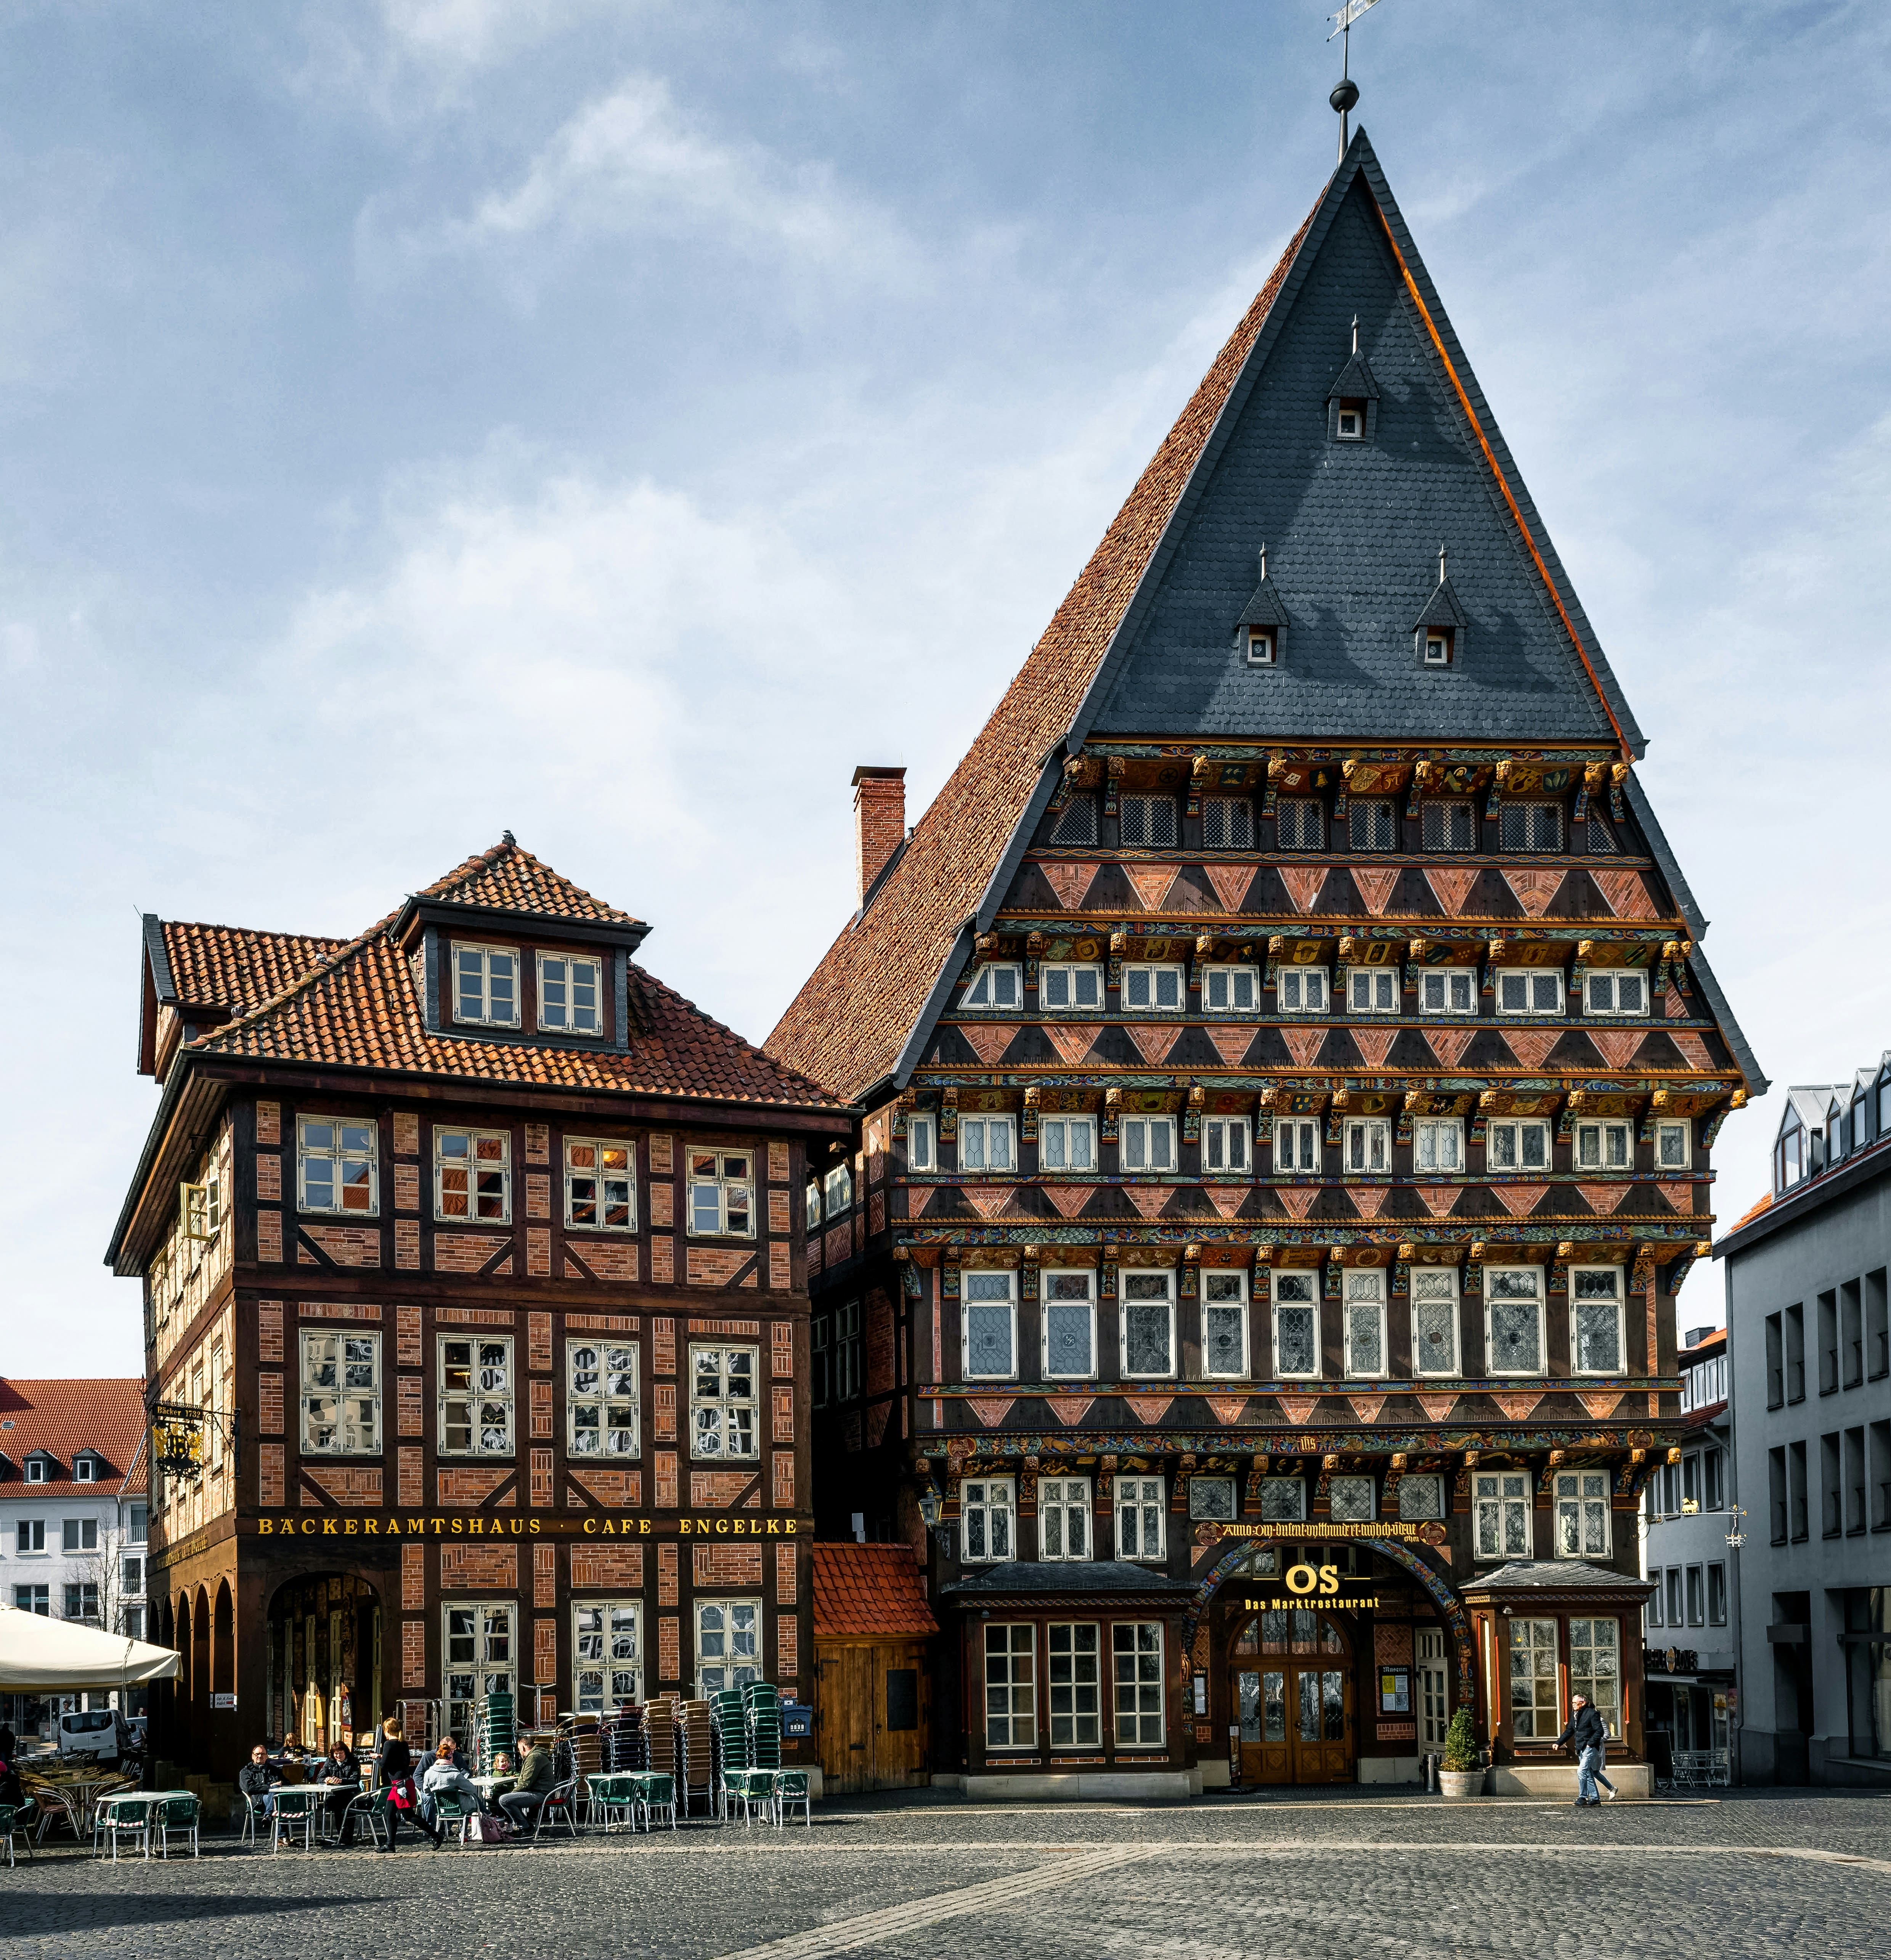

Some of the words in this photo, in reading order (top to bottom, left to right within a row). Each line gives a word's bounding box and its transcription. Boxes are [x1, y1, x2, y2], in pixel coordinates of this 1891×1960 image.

[157, 1406, 181, 1416] Bäcker
[185, 1410, 201, 1418] 1732
[258, 1518, 540, 1534] BÄCKERAMTSHAUS
[583, 1519, 651, 1534] CAFE
[679, 1519, 796, 1534] ENGELKE
[1286, 1565, 1339, 1594] OS
[1245, 1599, 1266, 1610] Das
[1272, 1597, 1379, 1610] Marktrestaurant
